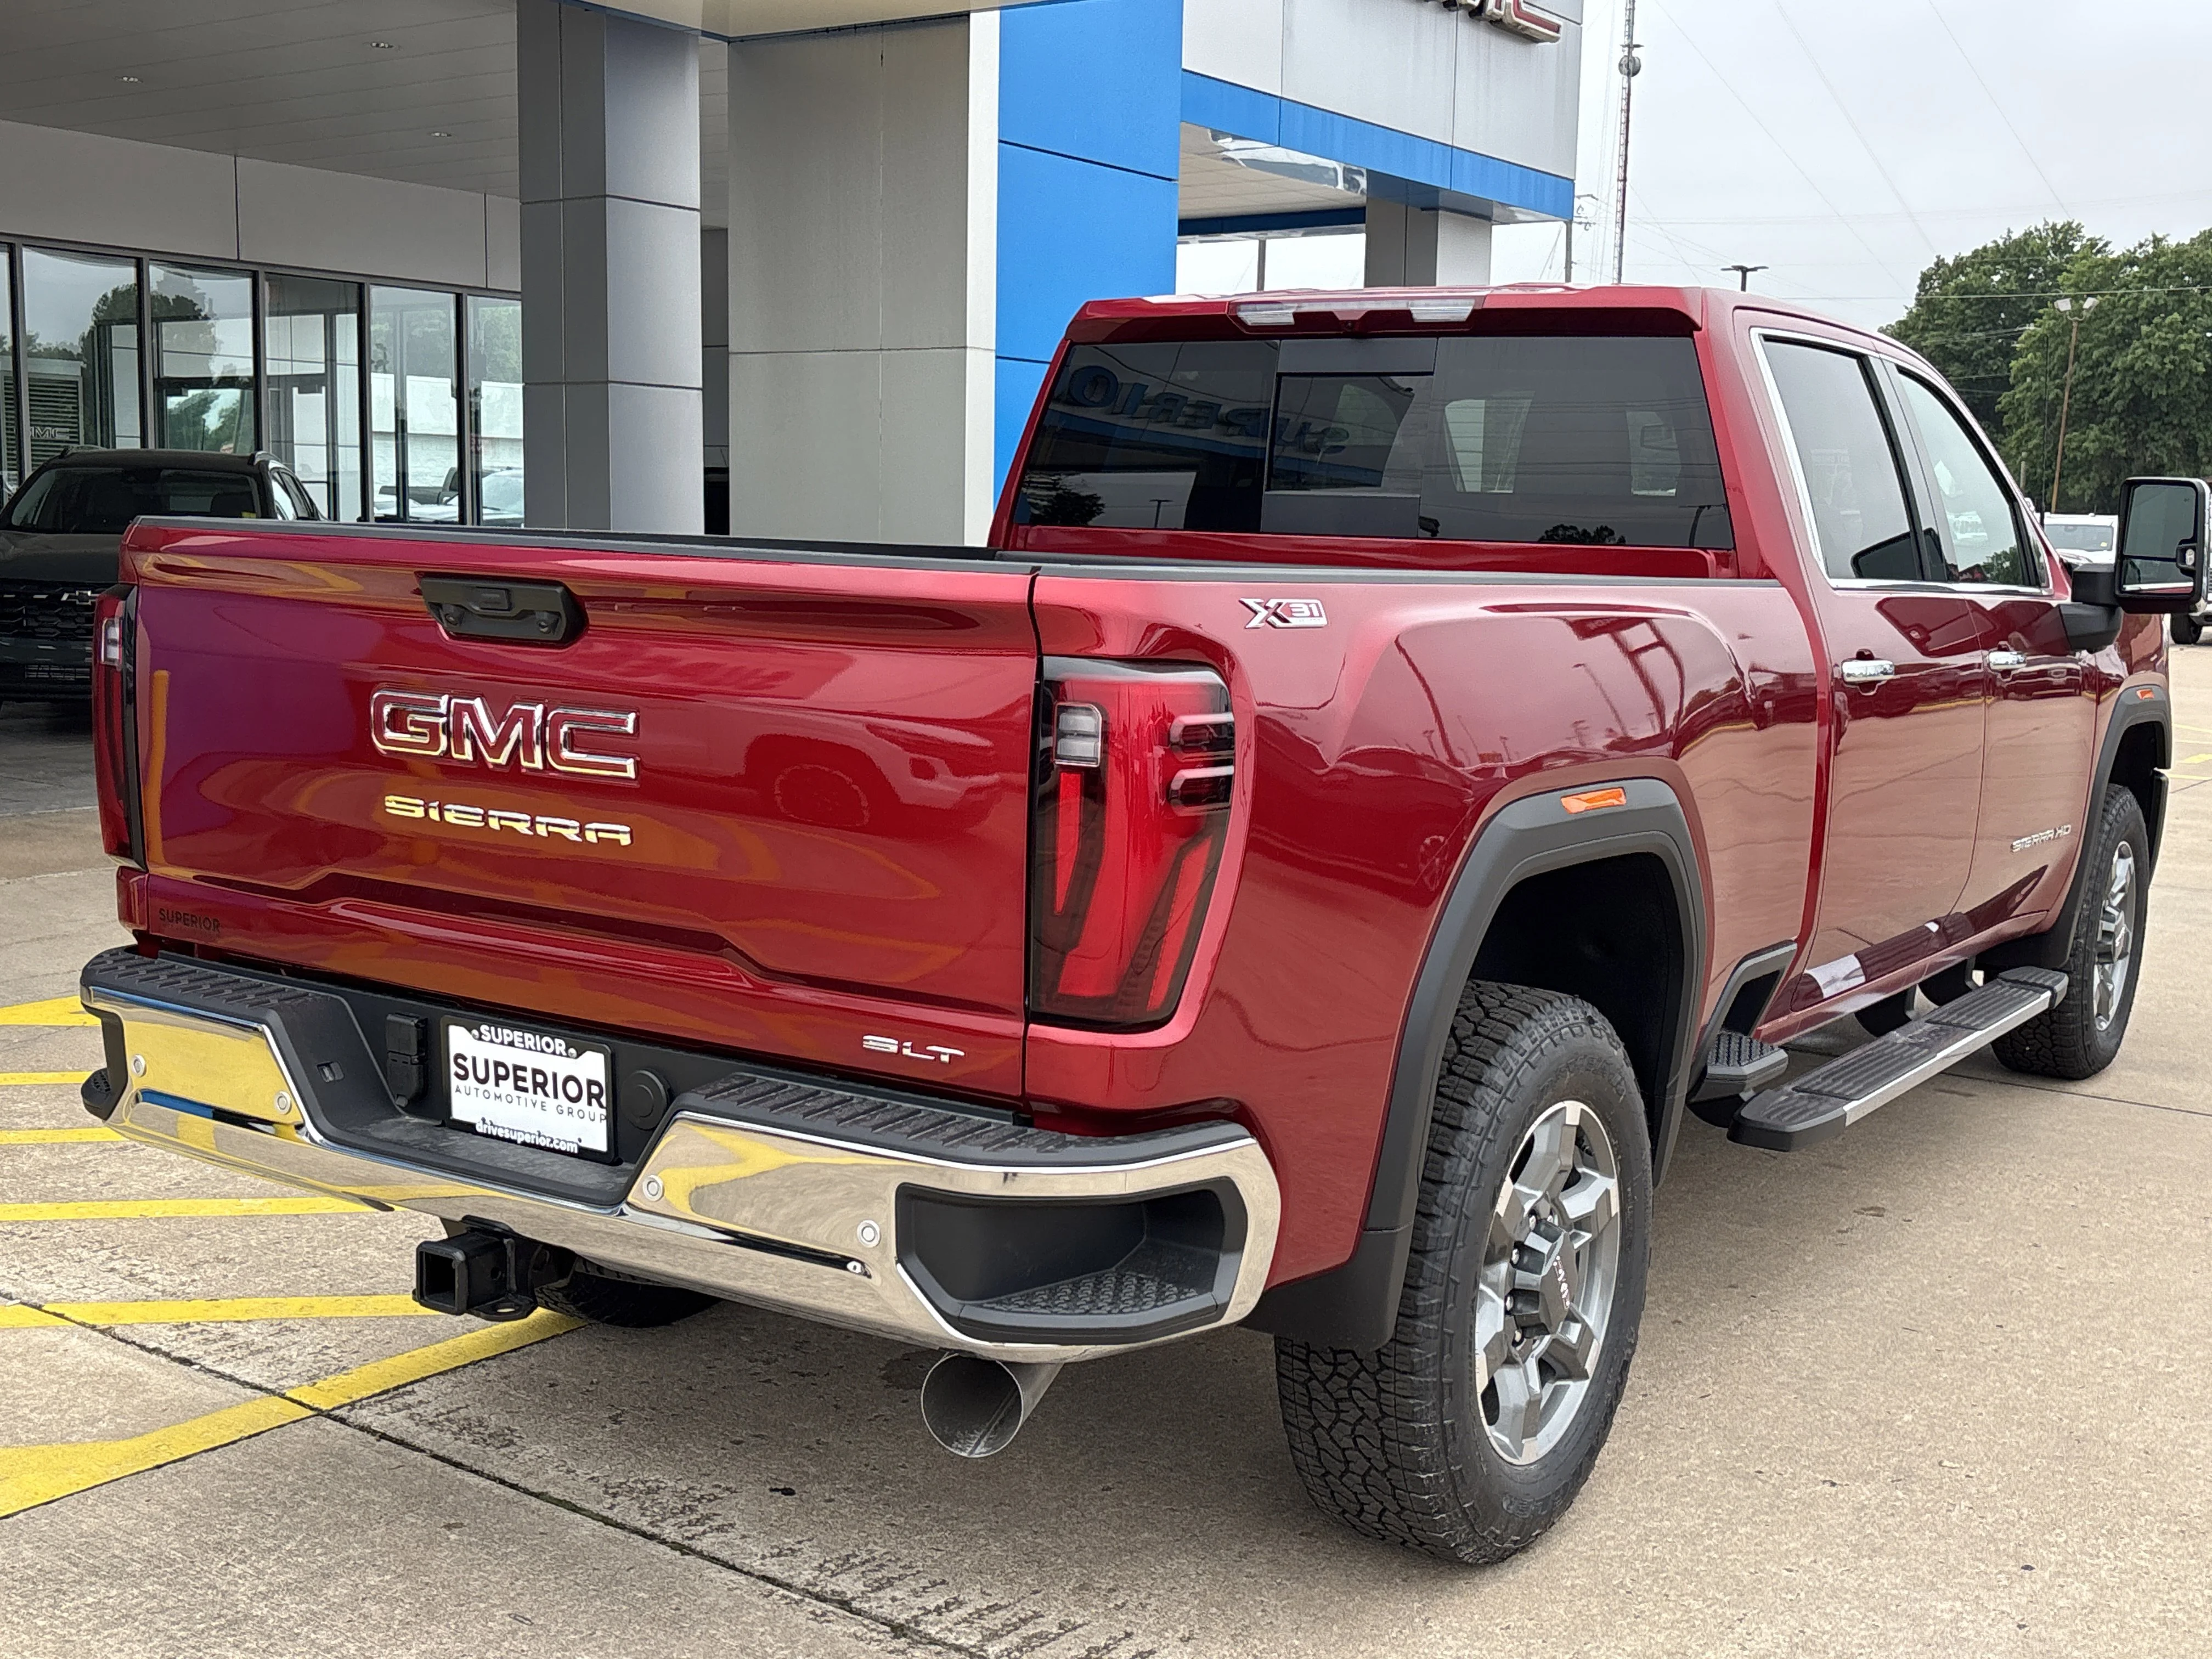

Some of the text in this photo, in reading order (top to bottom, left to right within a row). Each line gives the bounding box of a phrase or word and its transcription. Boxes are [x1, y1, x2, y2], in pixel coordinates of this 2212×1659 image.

[14, 426, 70, 439] MC
[1239, 598, 1328, 629] X31
[370, 687, 640, 780] GMC
[385, 794, 633, 847] SIERRA
[2011, 824, 2072, 853] SIERRA HD
[159, 907, 221, 933] SUPERIOR
[480, 1024, 567, 1057] SUPERIOR
[862, 1035, 966, 1064] SLT
[453, 1052, 606, 1109] SUPERIOR
[455, 1084, 606, 1124] AUTOMOTIVE GROUP
[476, 1119, 578, 1154] drivesuperior.com
